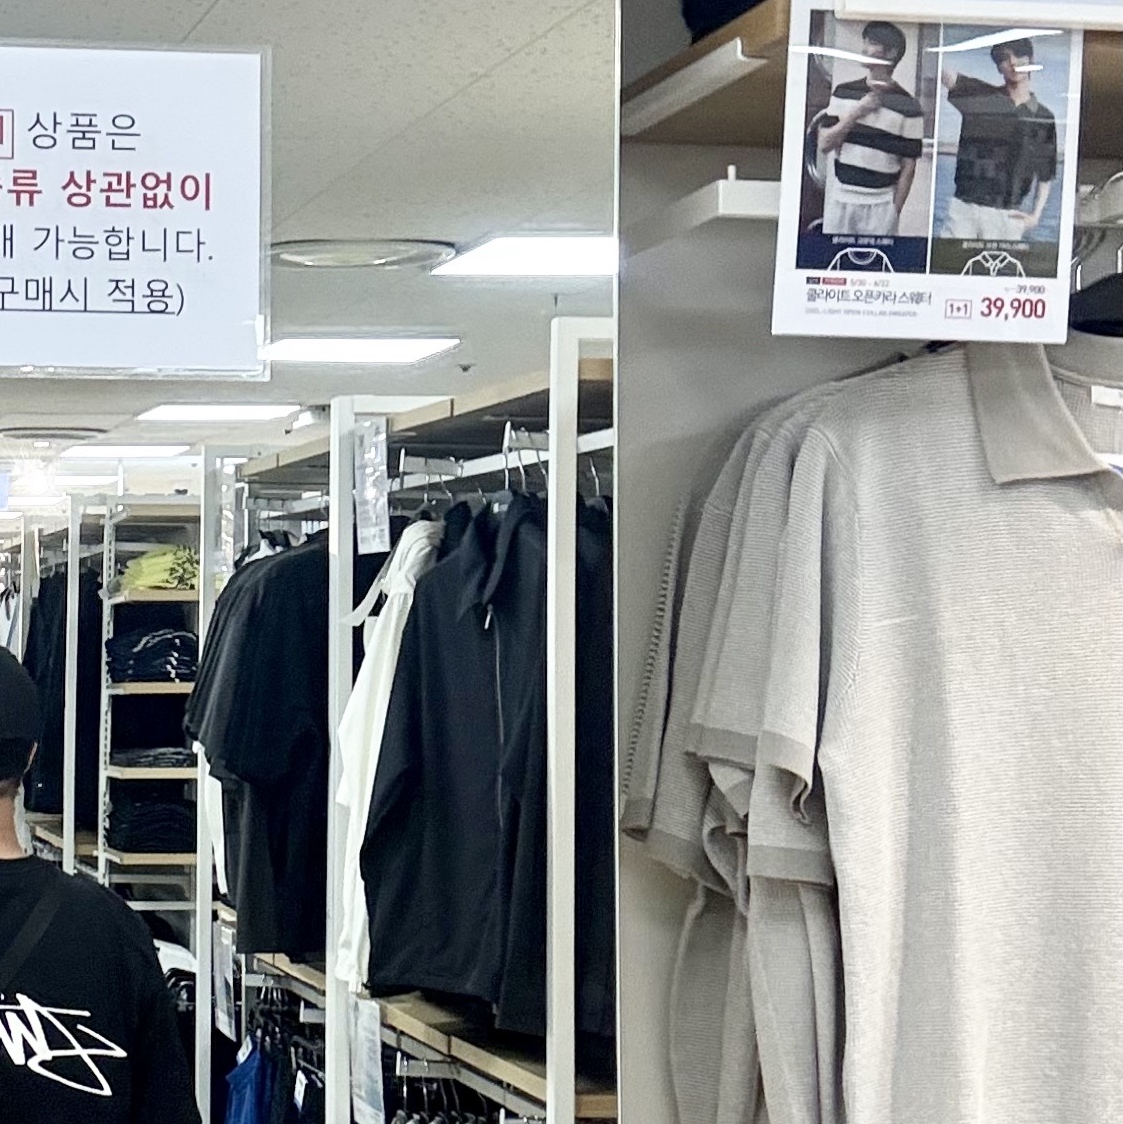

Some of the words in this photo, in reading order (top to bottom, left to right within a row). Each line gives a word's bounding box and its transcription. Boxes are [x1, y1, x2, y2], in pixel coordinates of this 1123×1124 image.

[26, 111, 141, 151] 상품은
[61, 169, 213, 211] 상관없이
[33, 225, 214, 262] 가능합니다.
[106, 278, 185, 316] 적용)
[949, 302, 969, 316] 1+1
[980, 296, 1047, 321] 39,900
